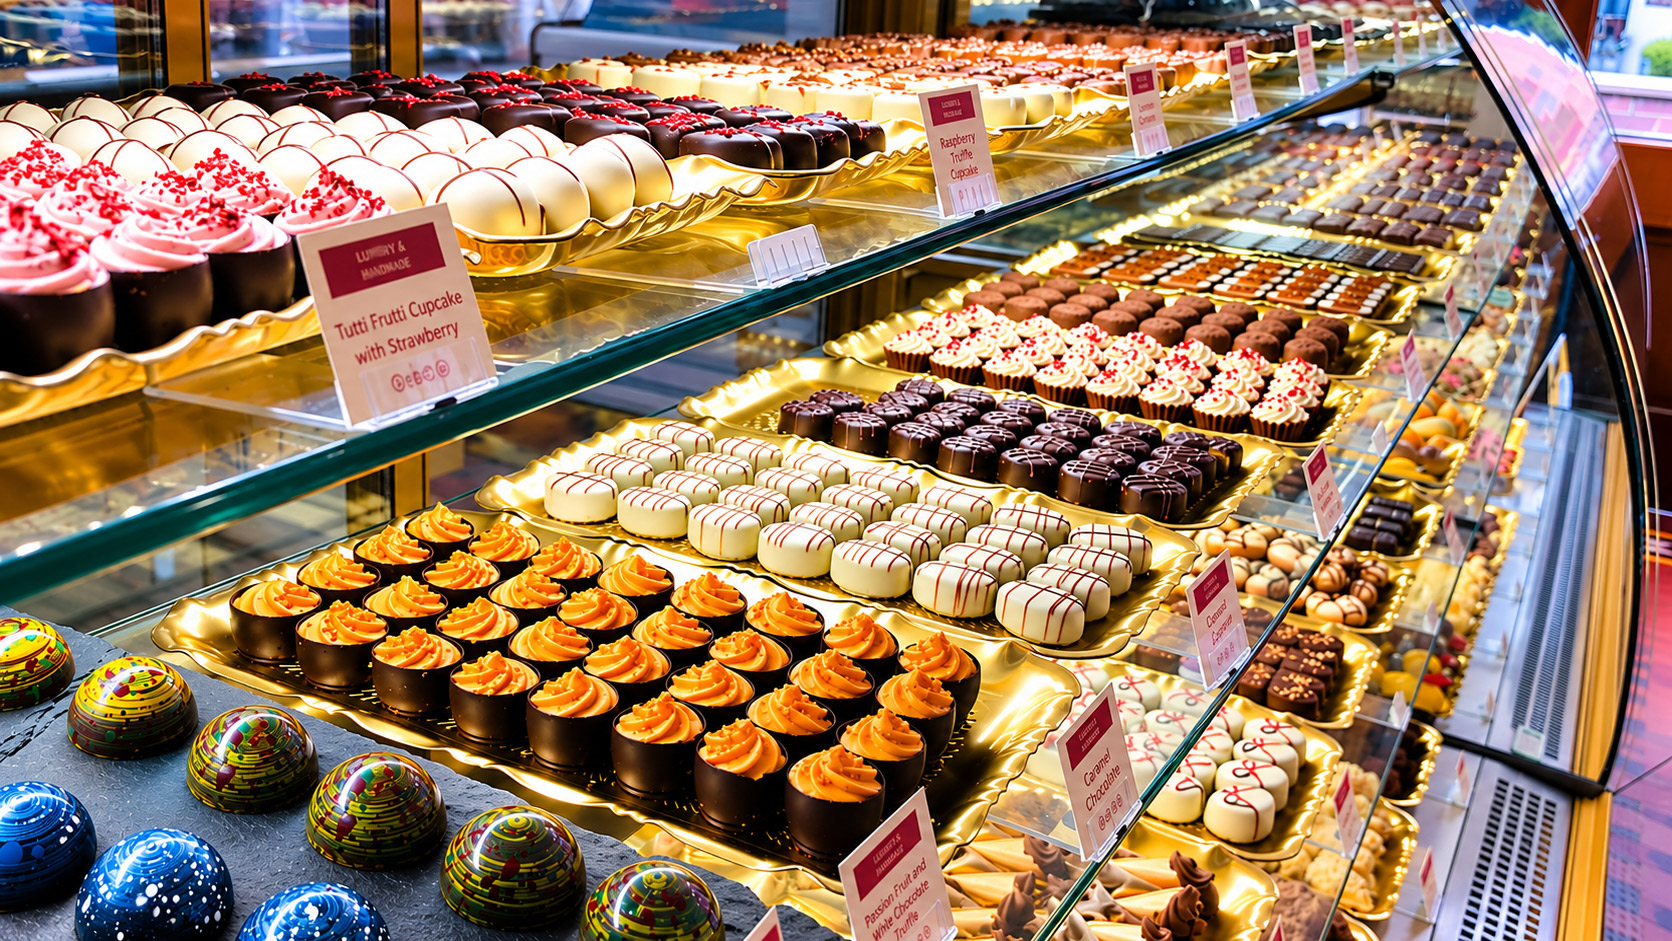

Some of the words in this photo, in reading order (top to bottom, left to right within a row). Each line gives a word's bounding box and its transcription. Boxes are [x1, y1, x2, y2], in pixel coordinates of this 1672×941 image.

[939, 133, 976, 149] Raspberry
[397, 240, 407, 252] &
[334, 315, 368, 341] Tutti
[369, 305, 408, 333] Frutti
[408, 290, 463, 319] Cupcake
[355, 341, 387, 365] with
[389, 321, 460, 355] Strawberry
[1083, 748, 1112, 787] Caramel
[1085, 764, 1121, 812] Chocolate
[864, 893, 895, 928] Passion
[893, 873, 913, 898] Fruit
[912, 857, 927, 880] and
[893, 880, 930, 919] Chocolate
